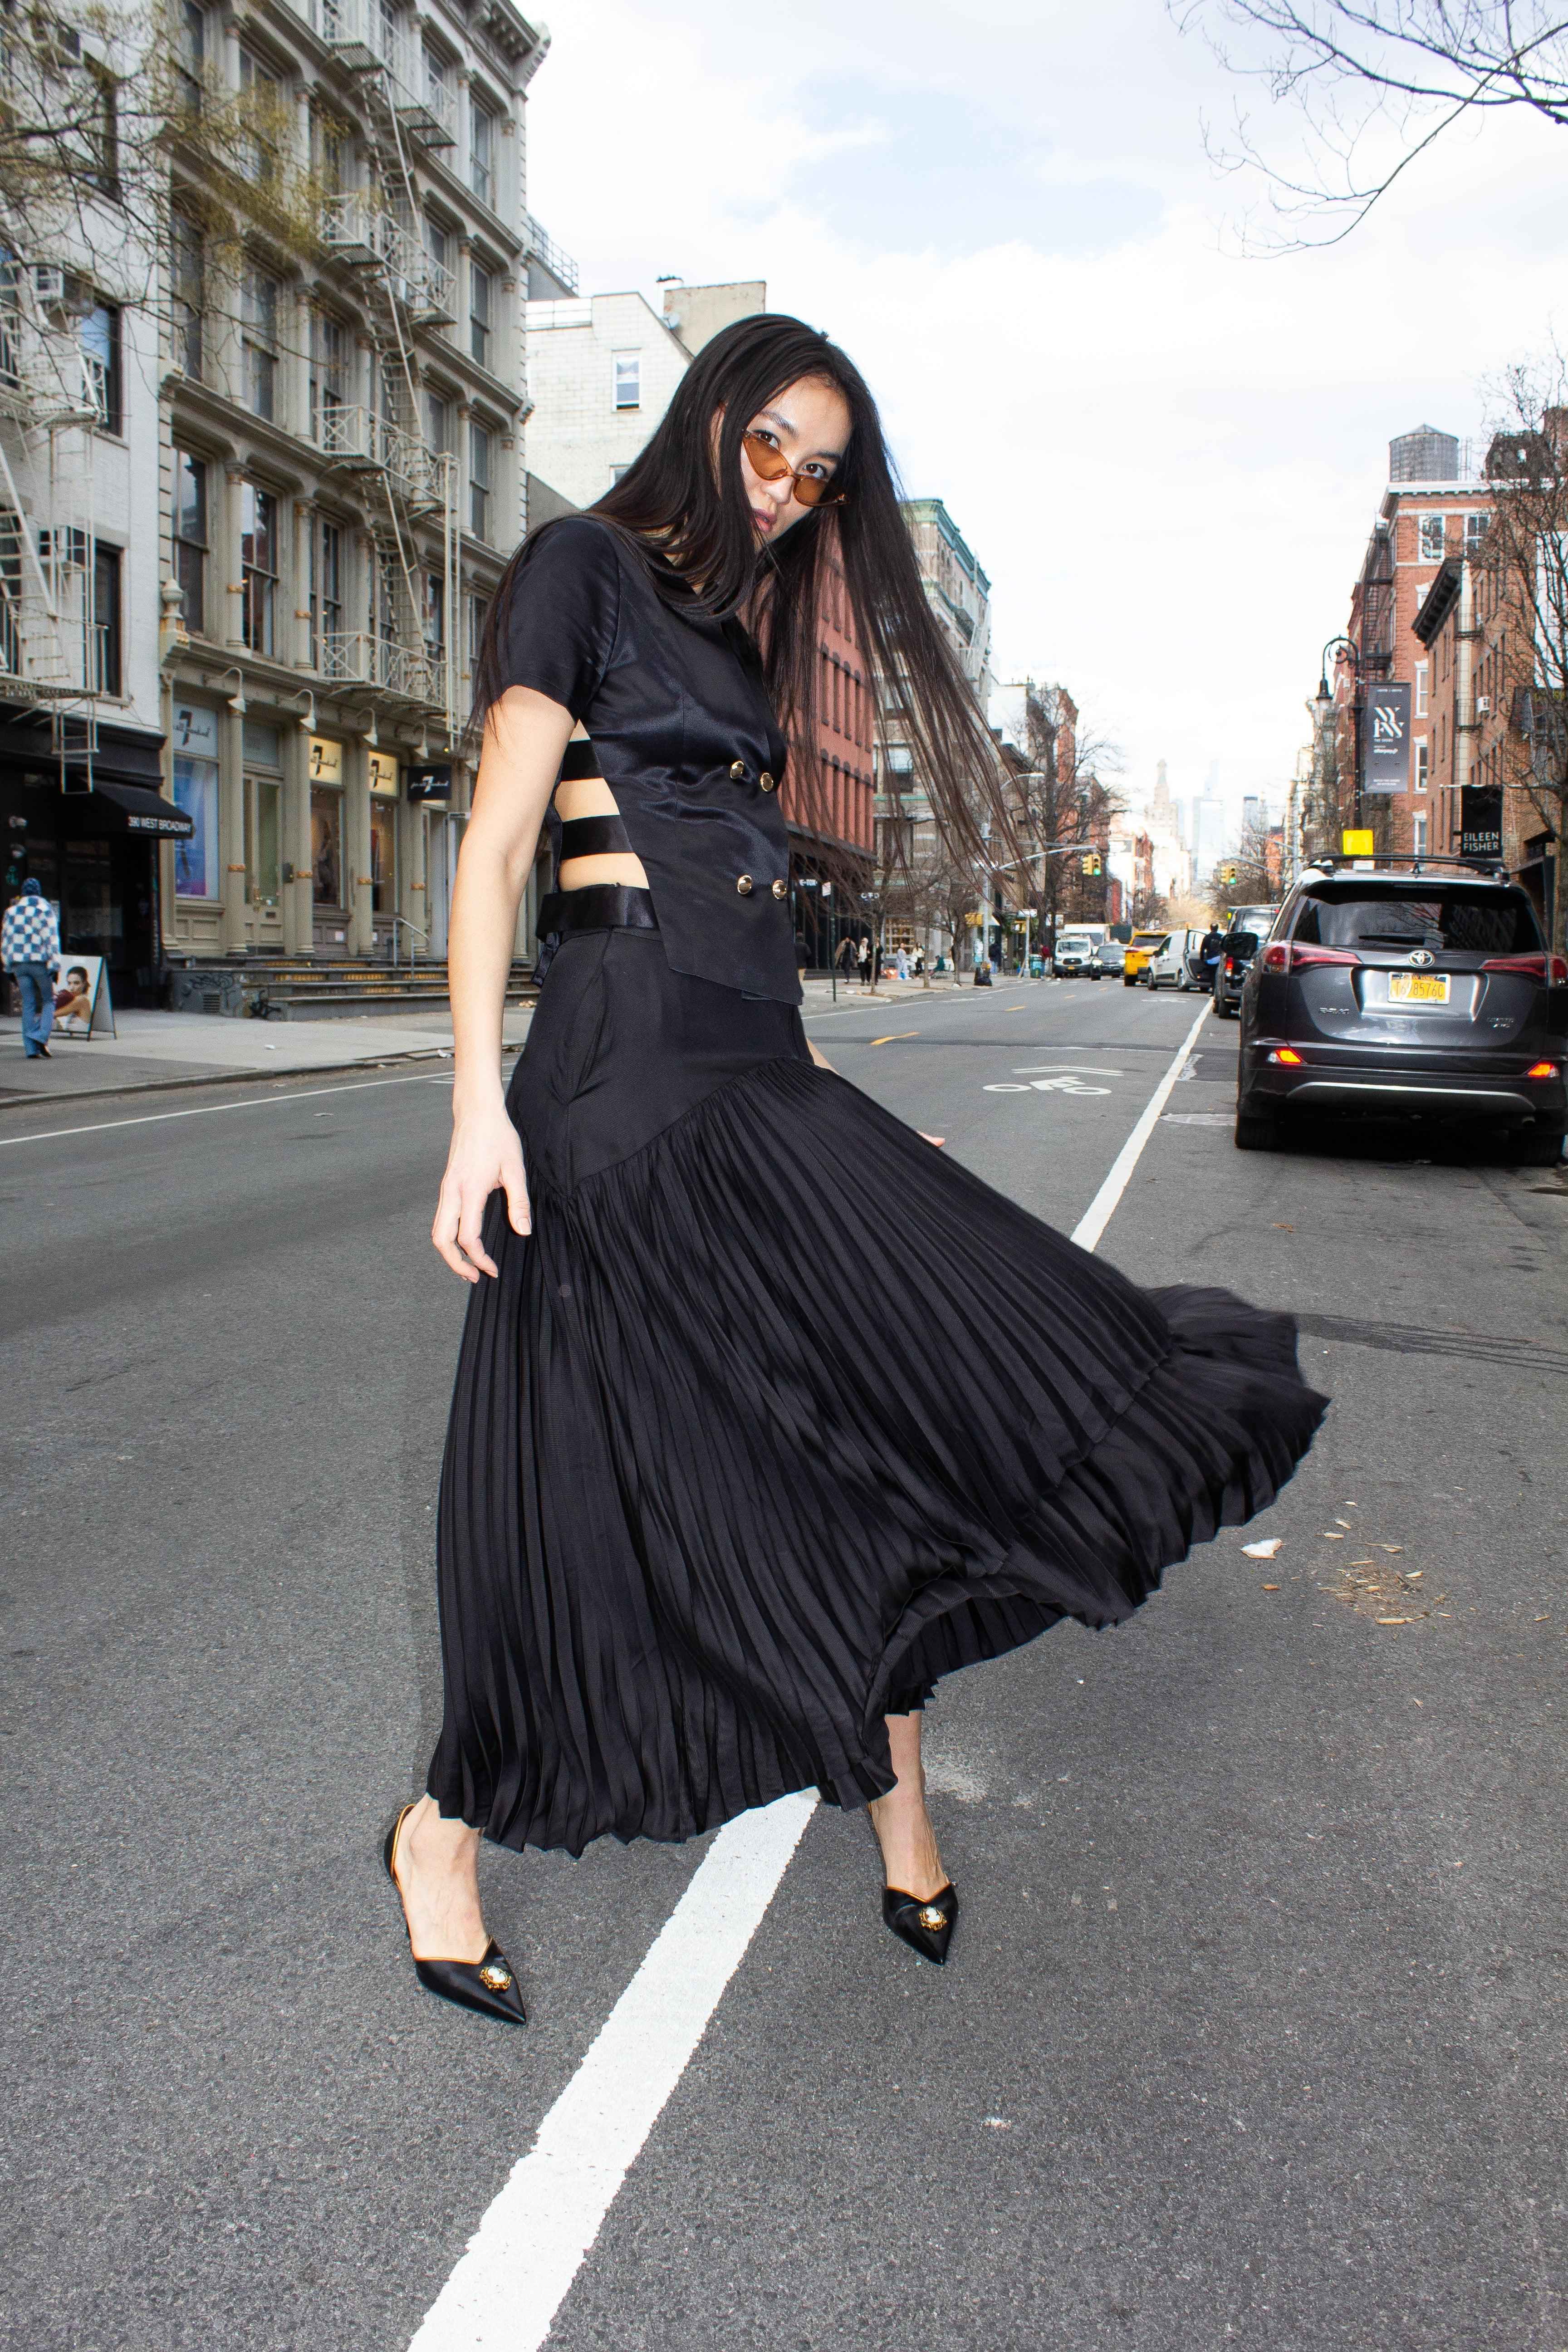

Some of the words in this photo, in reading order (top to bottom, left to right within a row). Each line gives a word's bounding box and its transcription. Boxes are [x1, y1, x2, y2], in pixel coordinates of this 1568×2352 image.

[313, 745, 323, 776] 7
[371, 760, 380, 788] 7
[422, 776, 434, 793] 7
[141, 817, 158, 830] WEST
[159, 818, 190, 833] BROADWAY
[1463, 831, 1499, 842] EILEEN
[1463, 841, 1499, 852] FISHER
